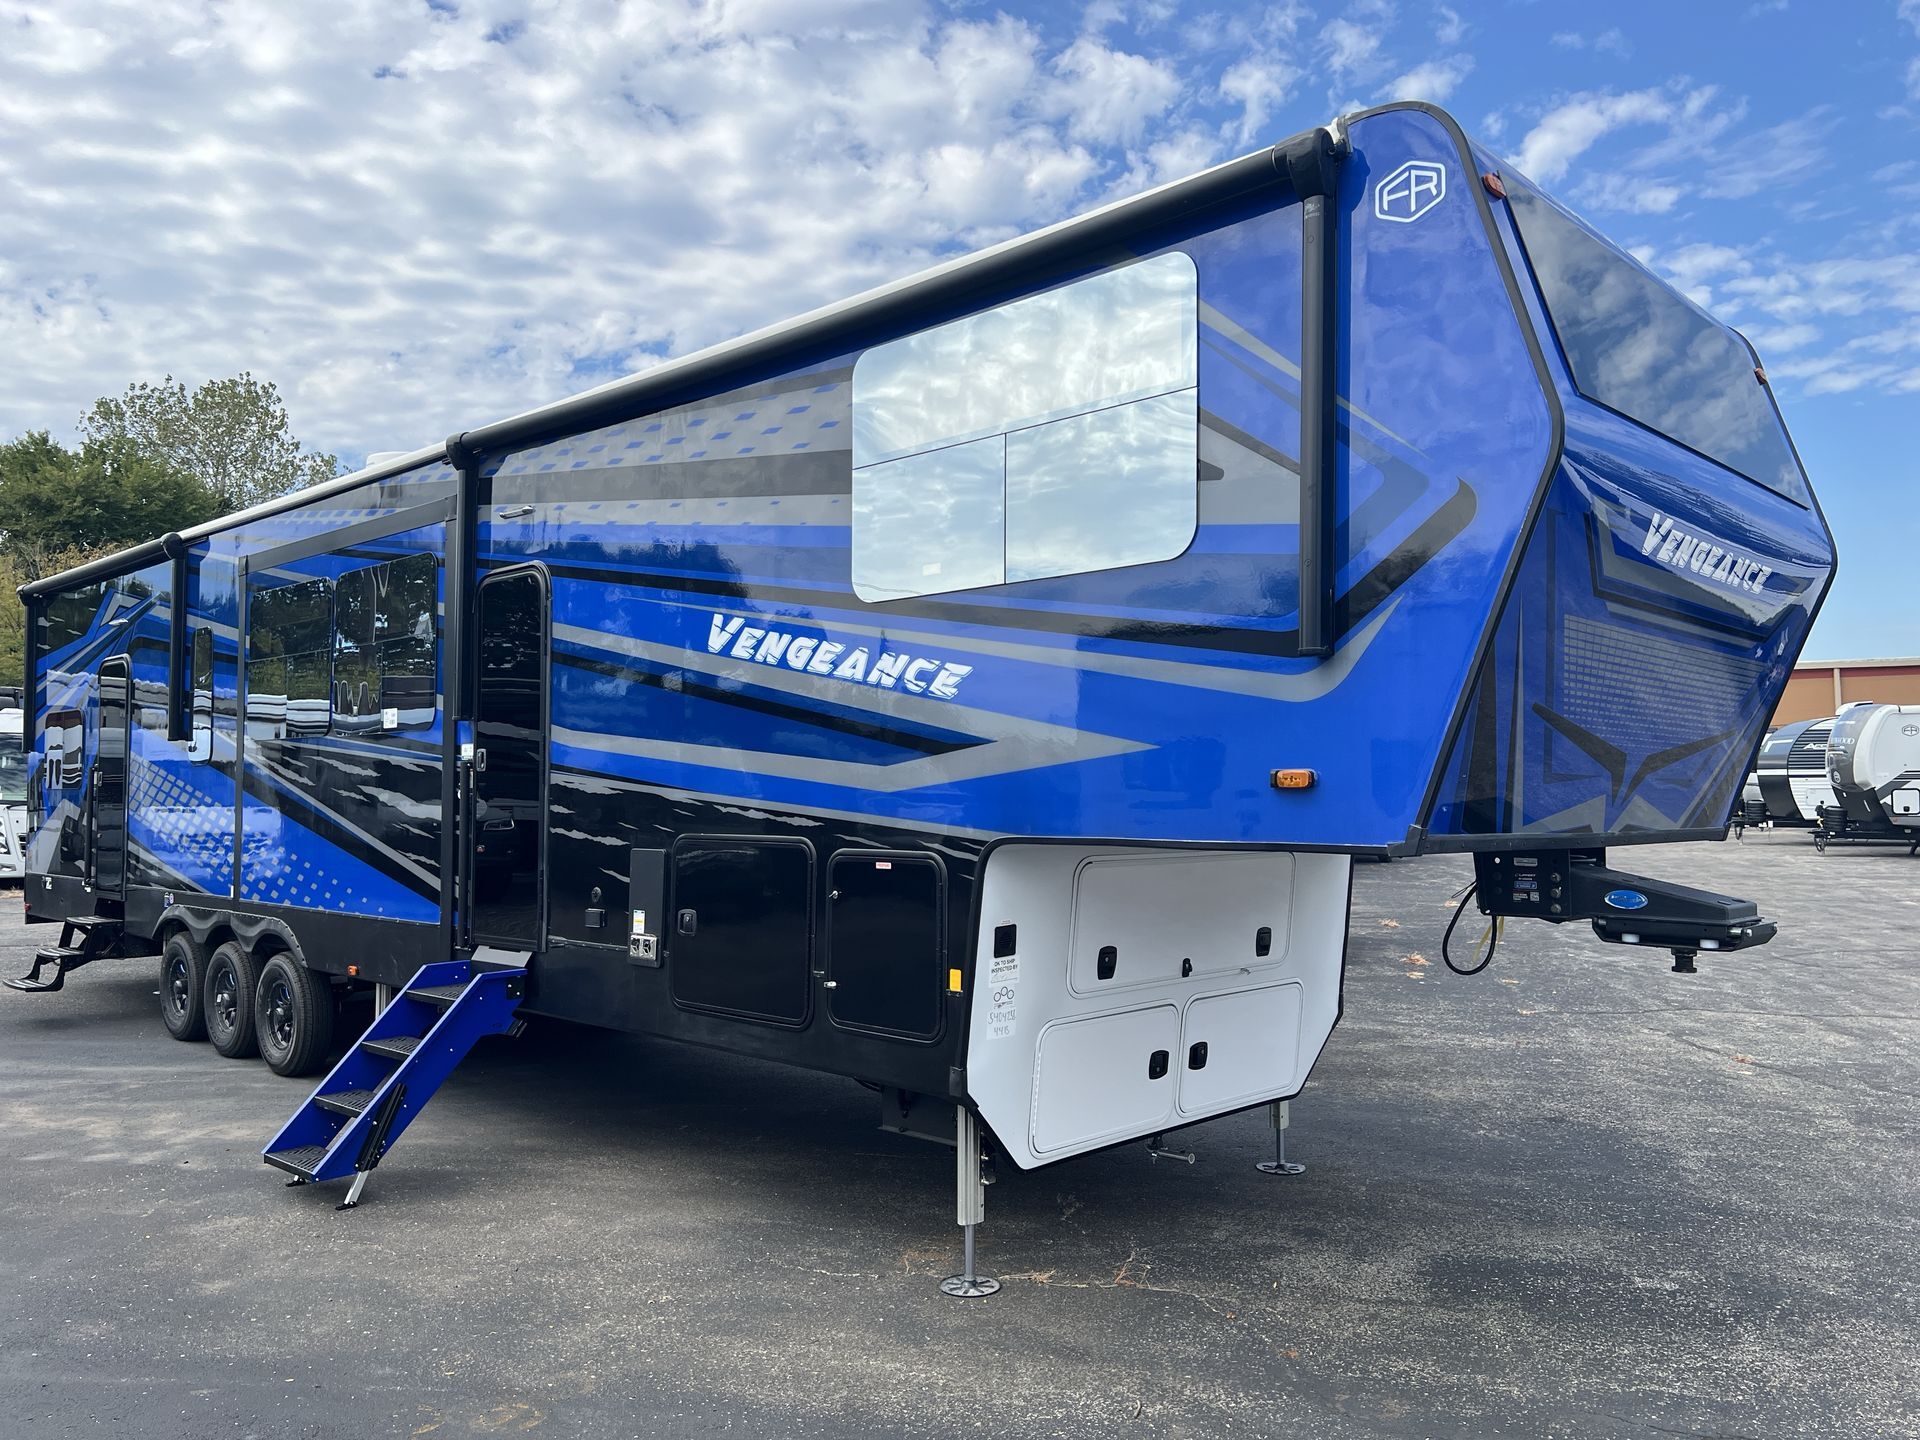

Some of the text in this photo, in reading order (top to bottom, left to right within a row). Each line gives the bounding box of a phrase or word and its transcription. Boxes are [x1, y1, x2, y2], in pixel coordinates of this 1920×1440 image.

[1381, 168, 1439, 214] FR
[1642, 513, 1772, 595] VENGEANCE
[707, 613, 973, 700] VENGEANCE
